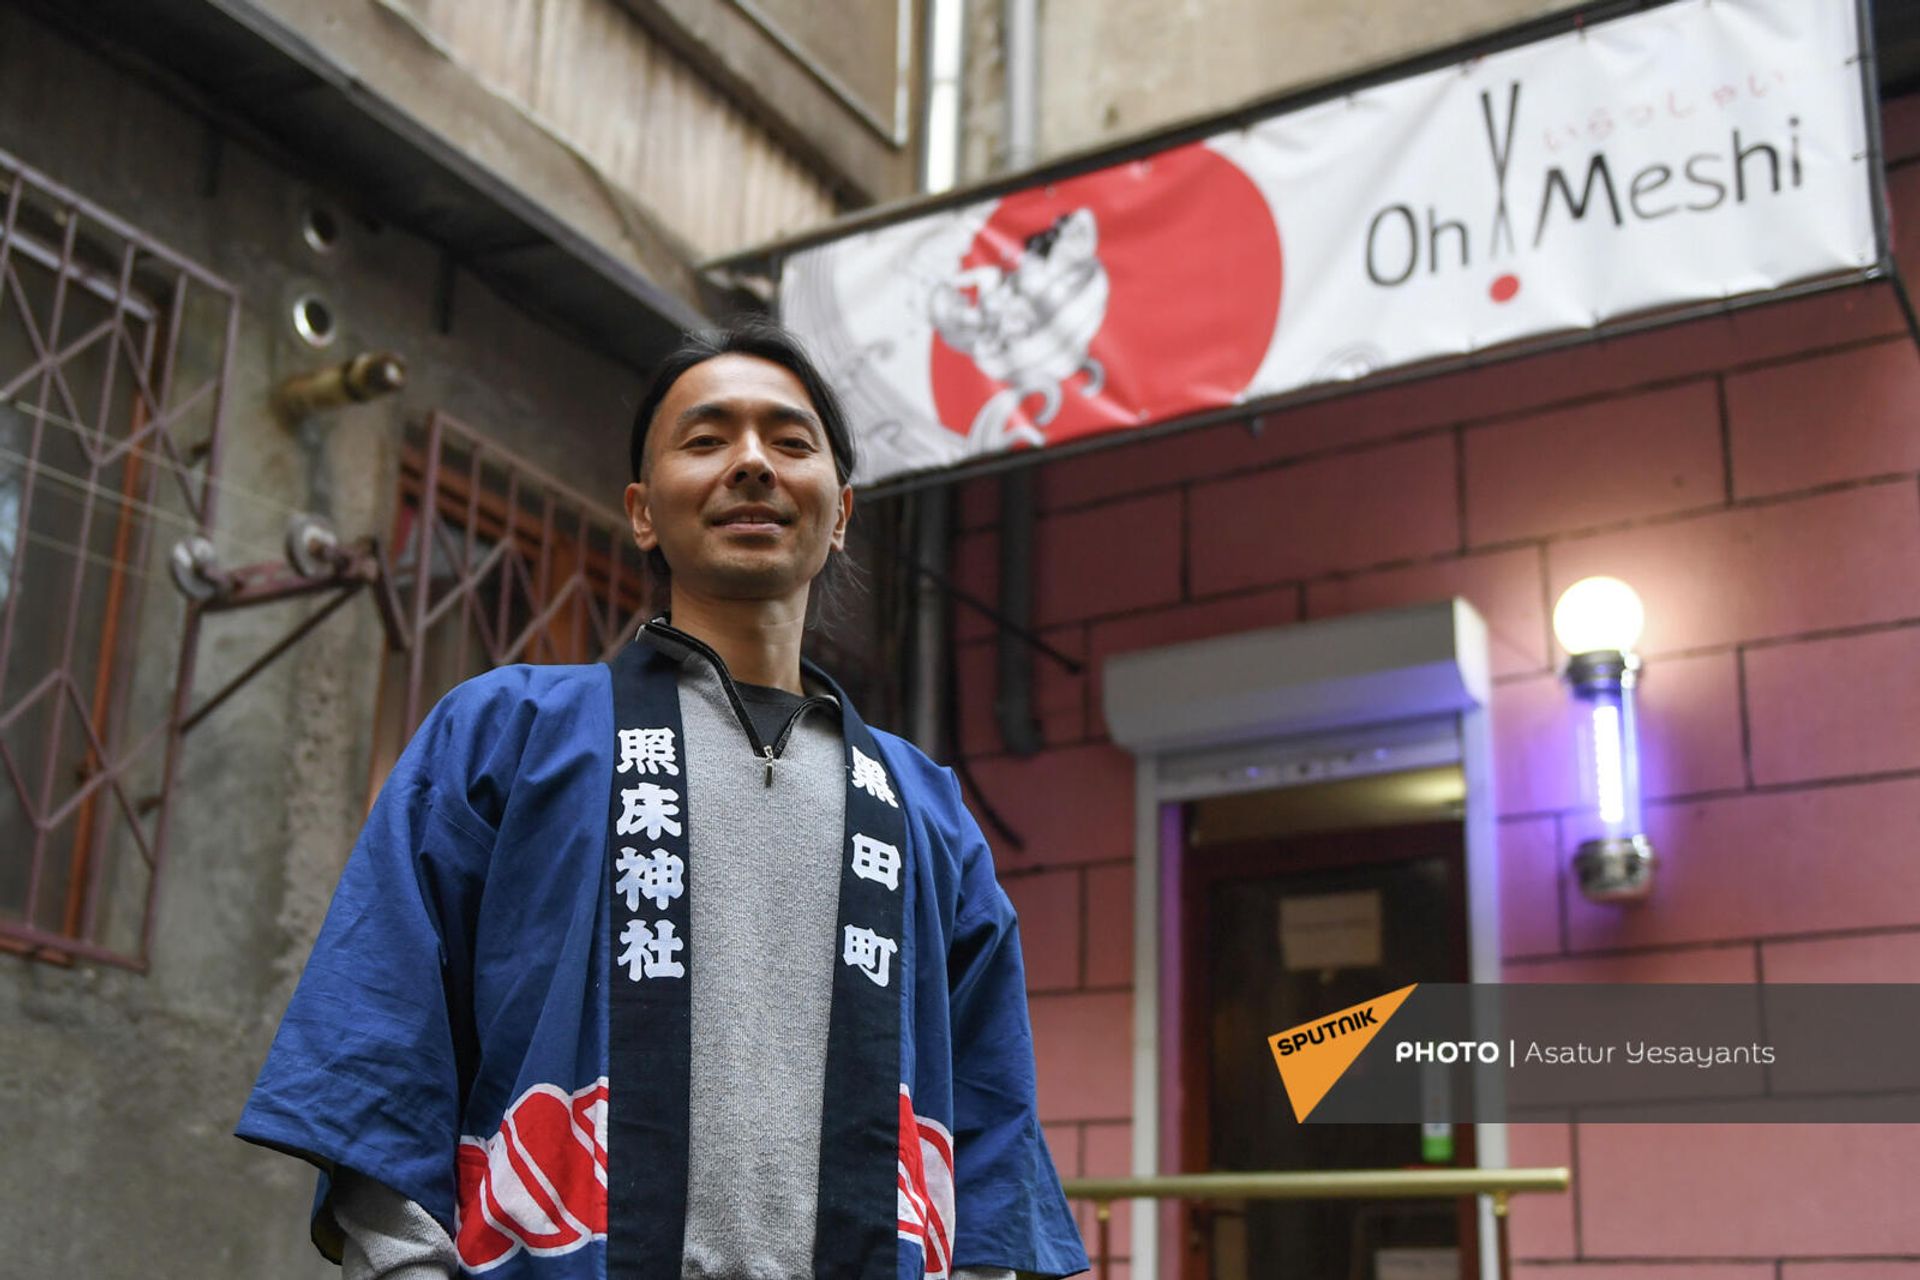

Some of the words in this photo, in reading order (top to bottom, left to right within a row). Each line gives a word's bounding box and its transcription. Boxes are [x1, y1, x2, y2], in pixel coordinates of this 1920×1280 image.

[1533, 115, 1803, 250] Meshi
[615, 727, 686, 982] 照床神社
